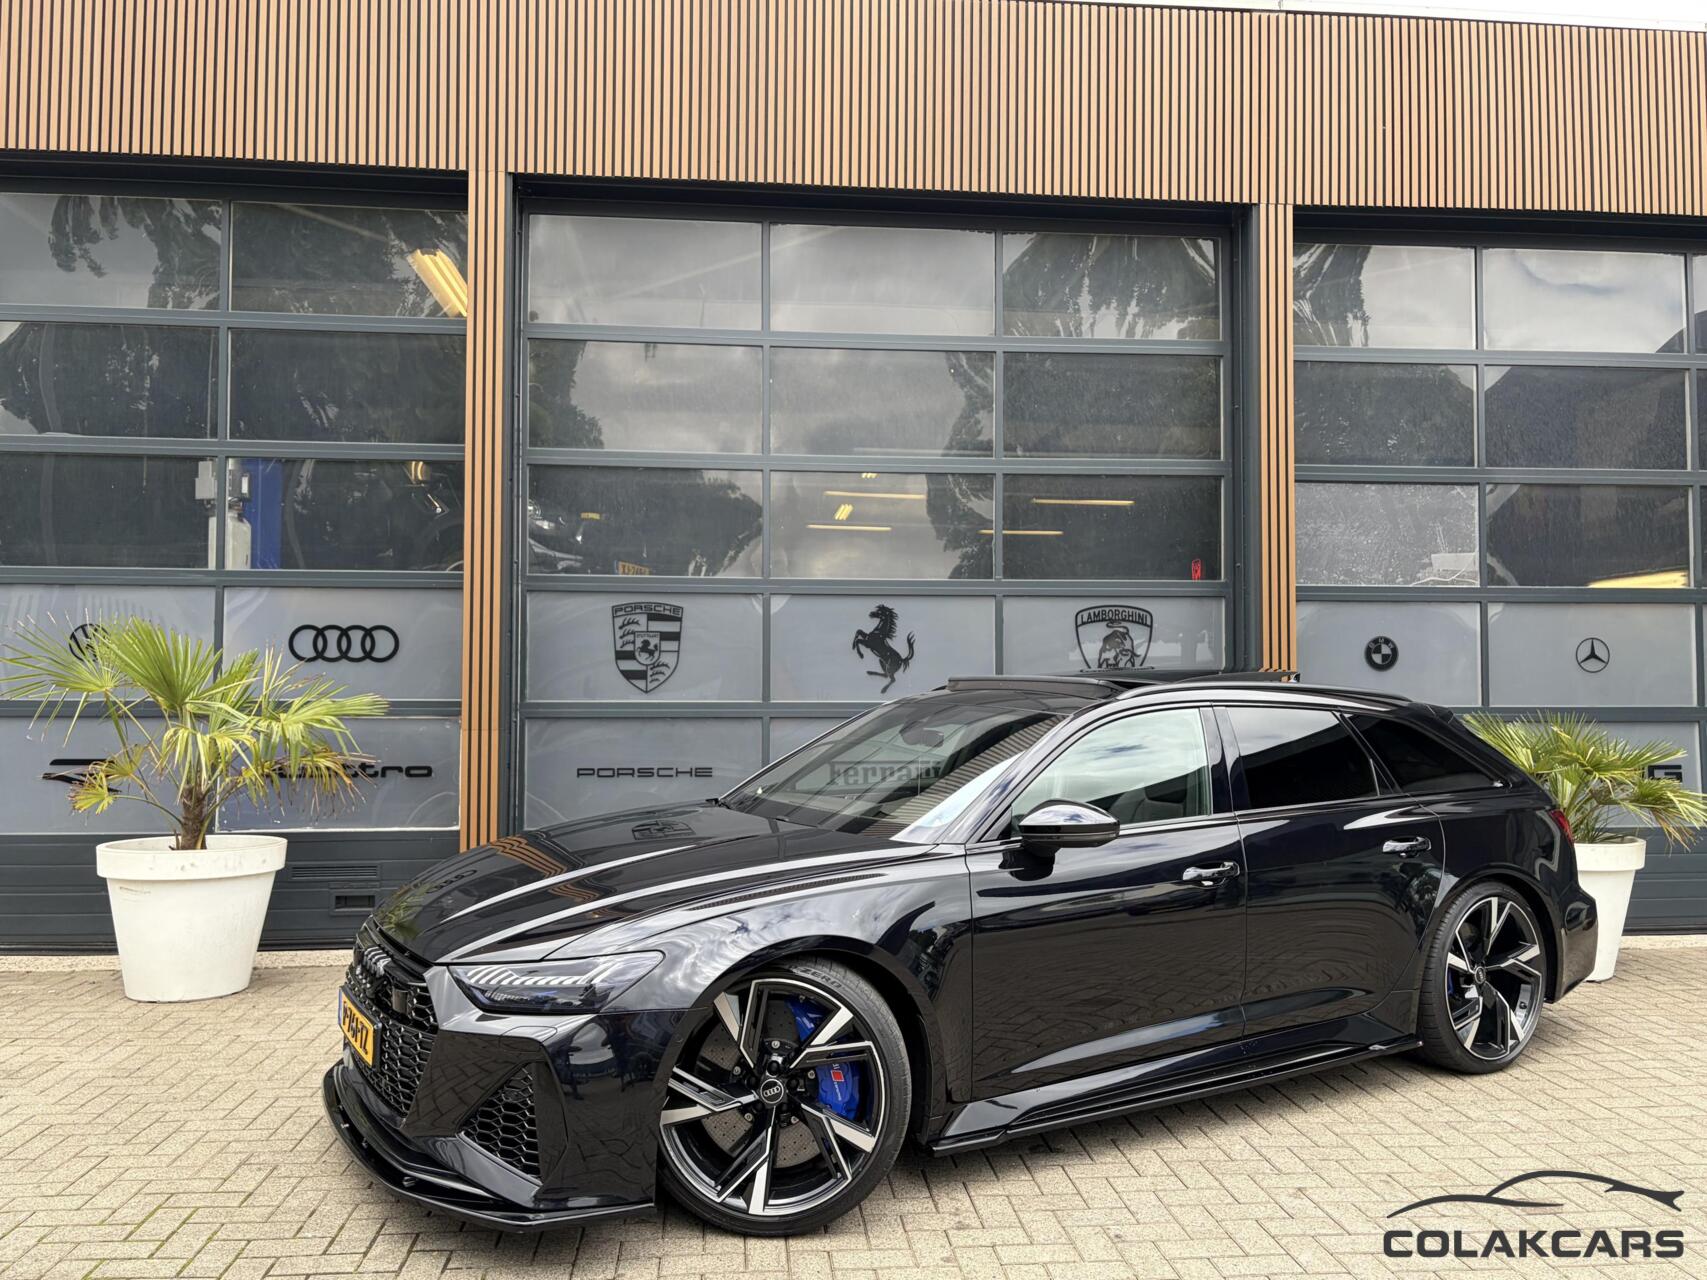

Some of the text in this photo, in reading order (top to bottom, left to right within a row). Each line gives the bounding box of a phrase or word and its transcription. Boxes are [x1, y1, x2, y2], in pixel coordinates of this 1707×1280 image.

[614, 604, 681, 616] PORSCHE
[1080, 608, 1149, 626] LAMBORGHINI
[576, 767, 713, 779] PORSCHE
